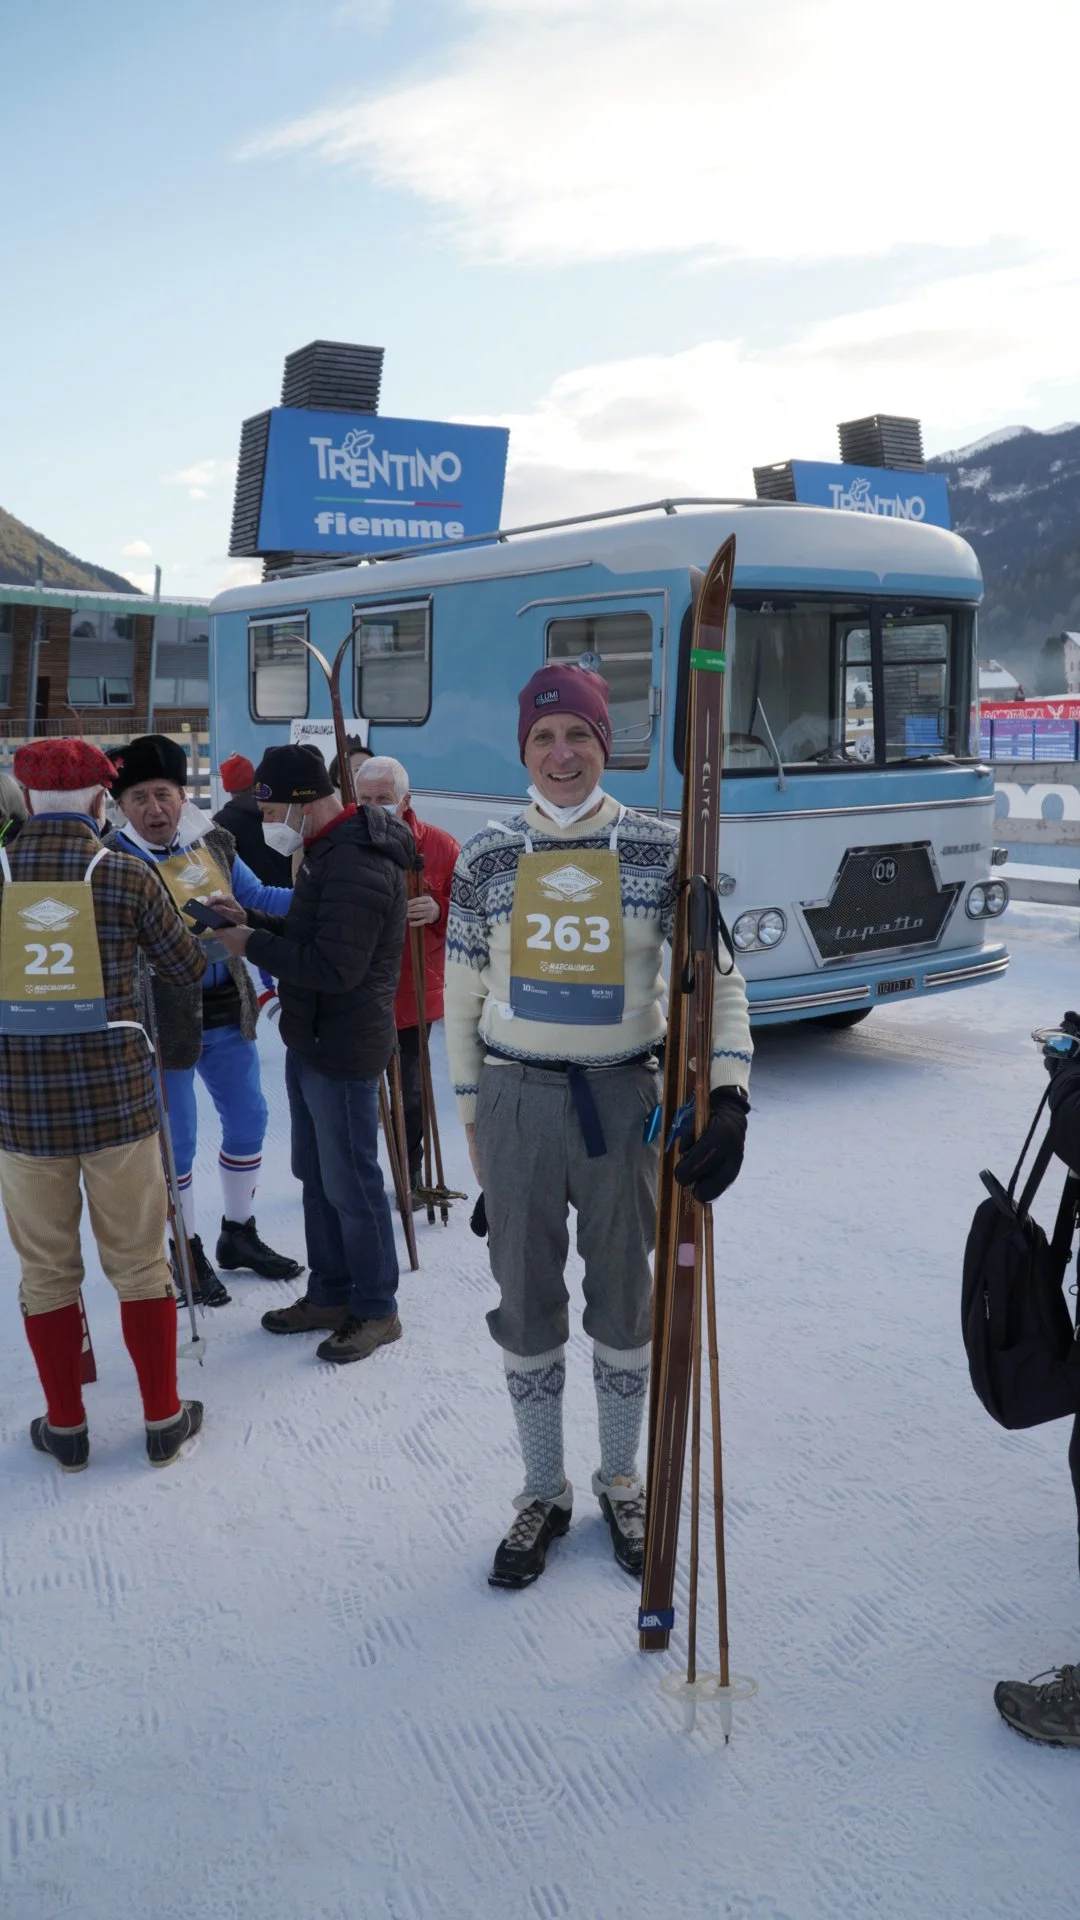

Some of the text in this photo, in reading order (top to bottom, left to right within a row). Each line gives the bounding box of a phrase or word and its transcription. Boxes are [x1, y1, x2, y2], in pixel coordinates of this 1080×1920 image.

[309, 436, 462, 491] TRENTINO
[314, 511, 465, 539] fiemme
[540, 690, 558, 702] LUMI
[701, 761, 712, 819] ELITE
[875, 862, 895, 879] OM
[526, 912, 611, 953] 263
[24, 942, 75, 975] 22
[522, 983, 531, 992] 10
